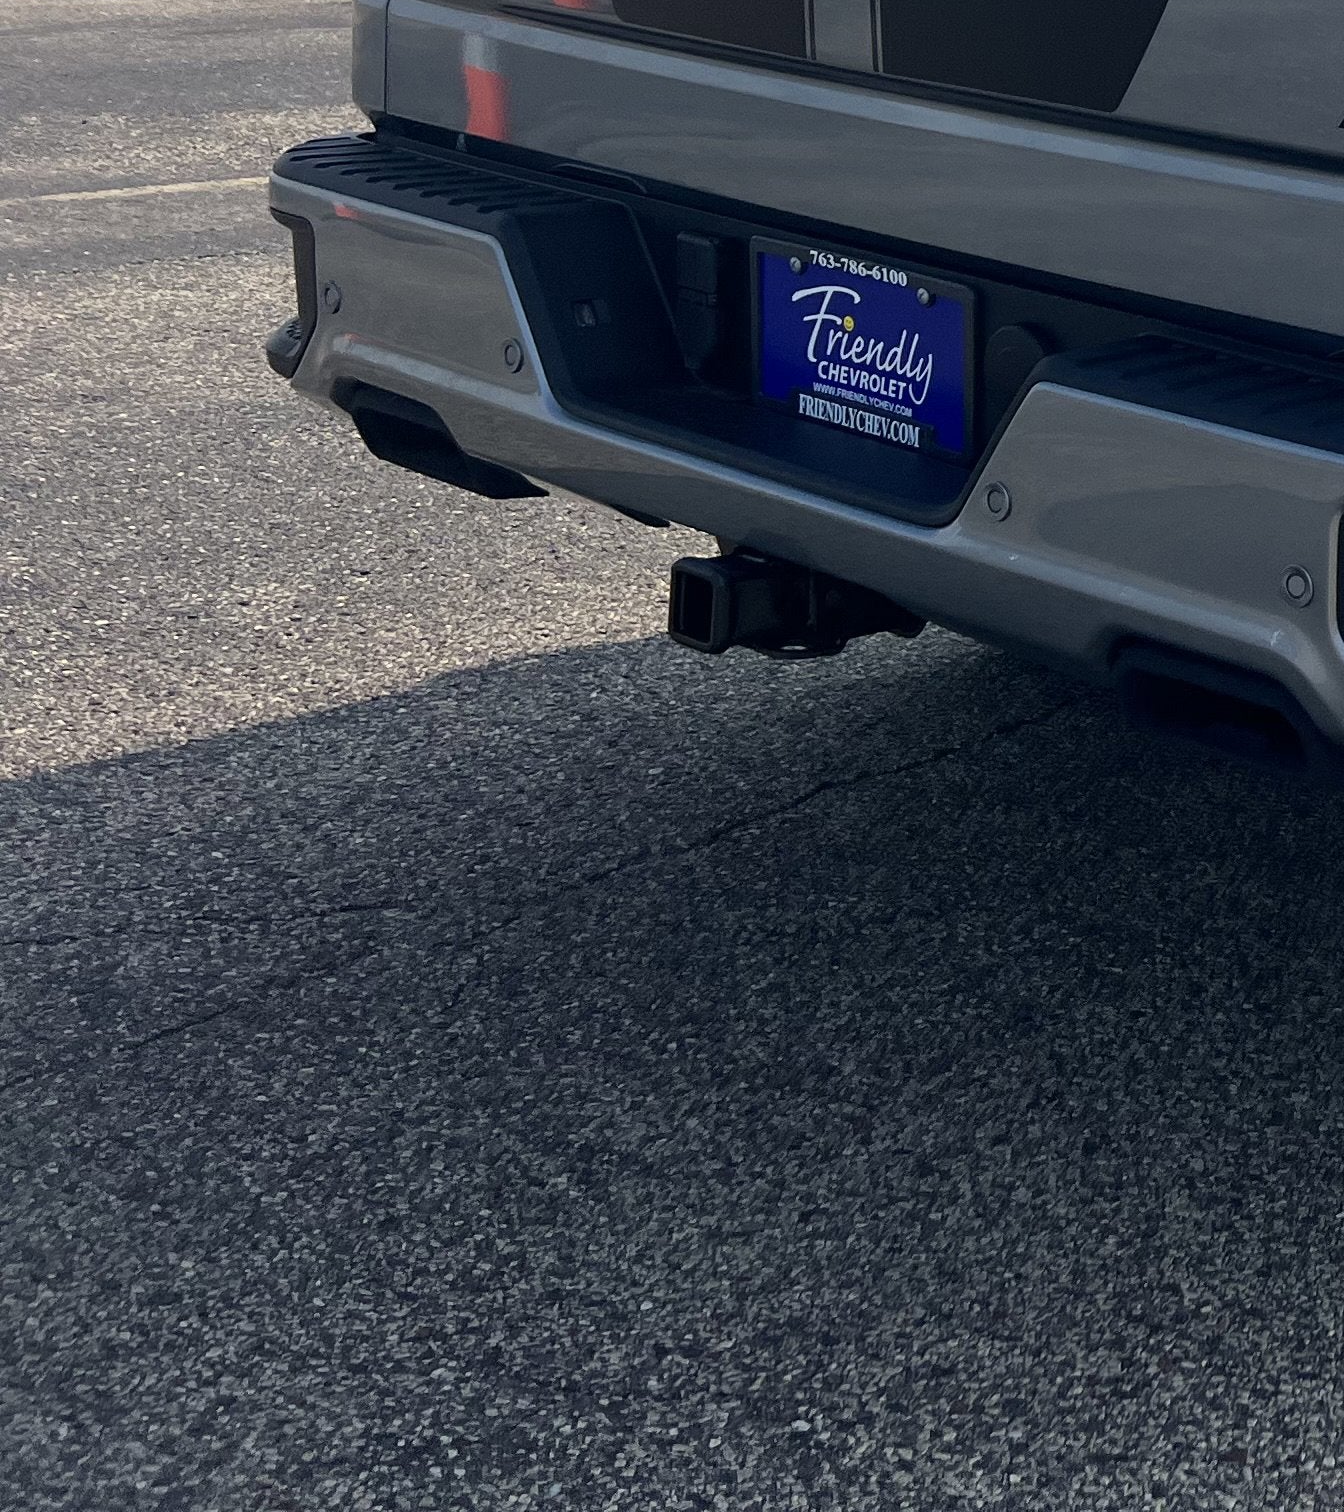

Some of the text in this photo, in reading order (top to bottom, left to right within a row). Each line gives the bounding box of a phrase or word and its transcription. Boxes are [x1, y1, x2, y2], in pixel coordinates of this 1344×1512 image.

[809, 249, 909, 287] 763-786-6100
[791, 285, 934, 406] Friendly
[817, 360, 907, 401] CHEVROLET
[798, 393, 922, 449] FRIENDLYCHEV.COM
